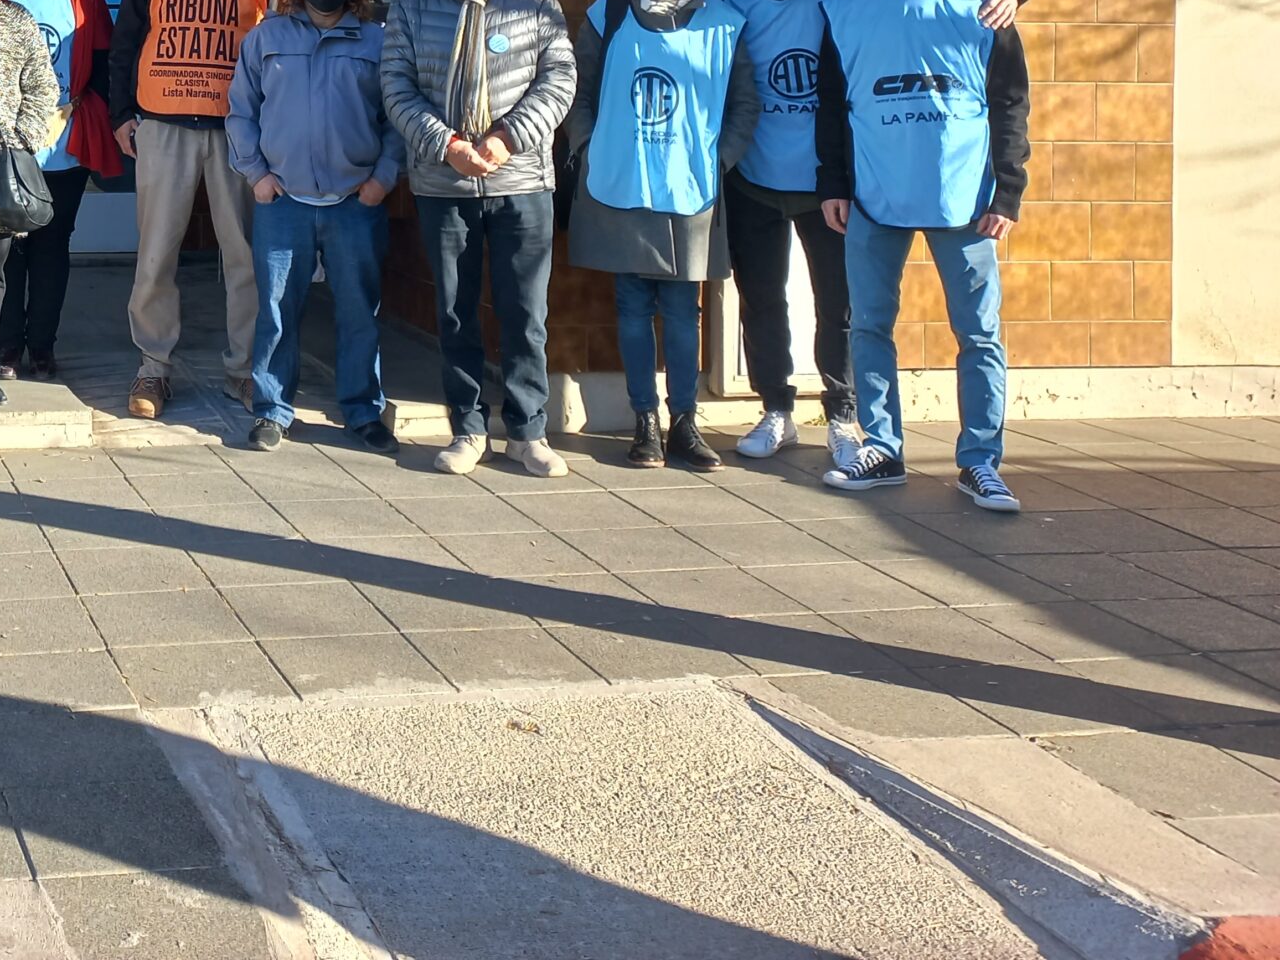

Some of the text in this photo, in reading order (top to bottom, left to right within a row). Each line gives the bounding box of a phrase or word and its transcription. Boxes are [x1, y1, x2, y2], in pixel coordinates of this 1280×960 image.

[156, 26, 238, 62] ESTATAL
[149, 69, 235, 82] COORDINADORA SINDICA
[175, 79, 210, 88] CLASISTA
[162, 87, 221, 102] Lista Naranja
[763, 103, 784, 114] LA
[881, 114, 902, 125] LA
